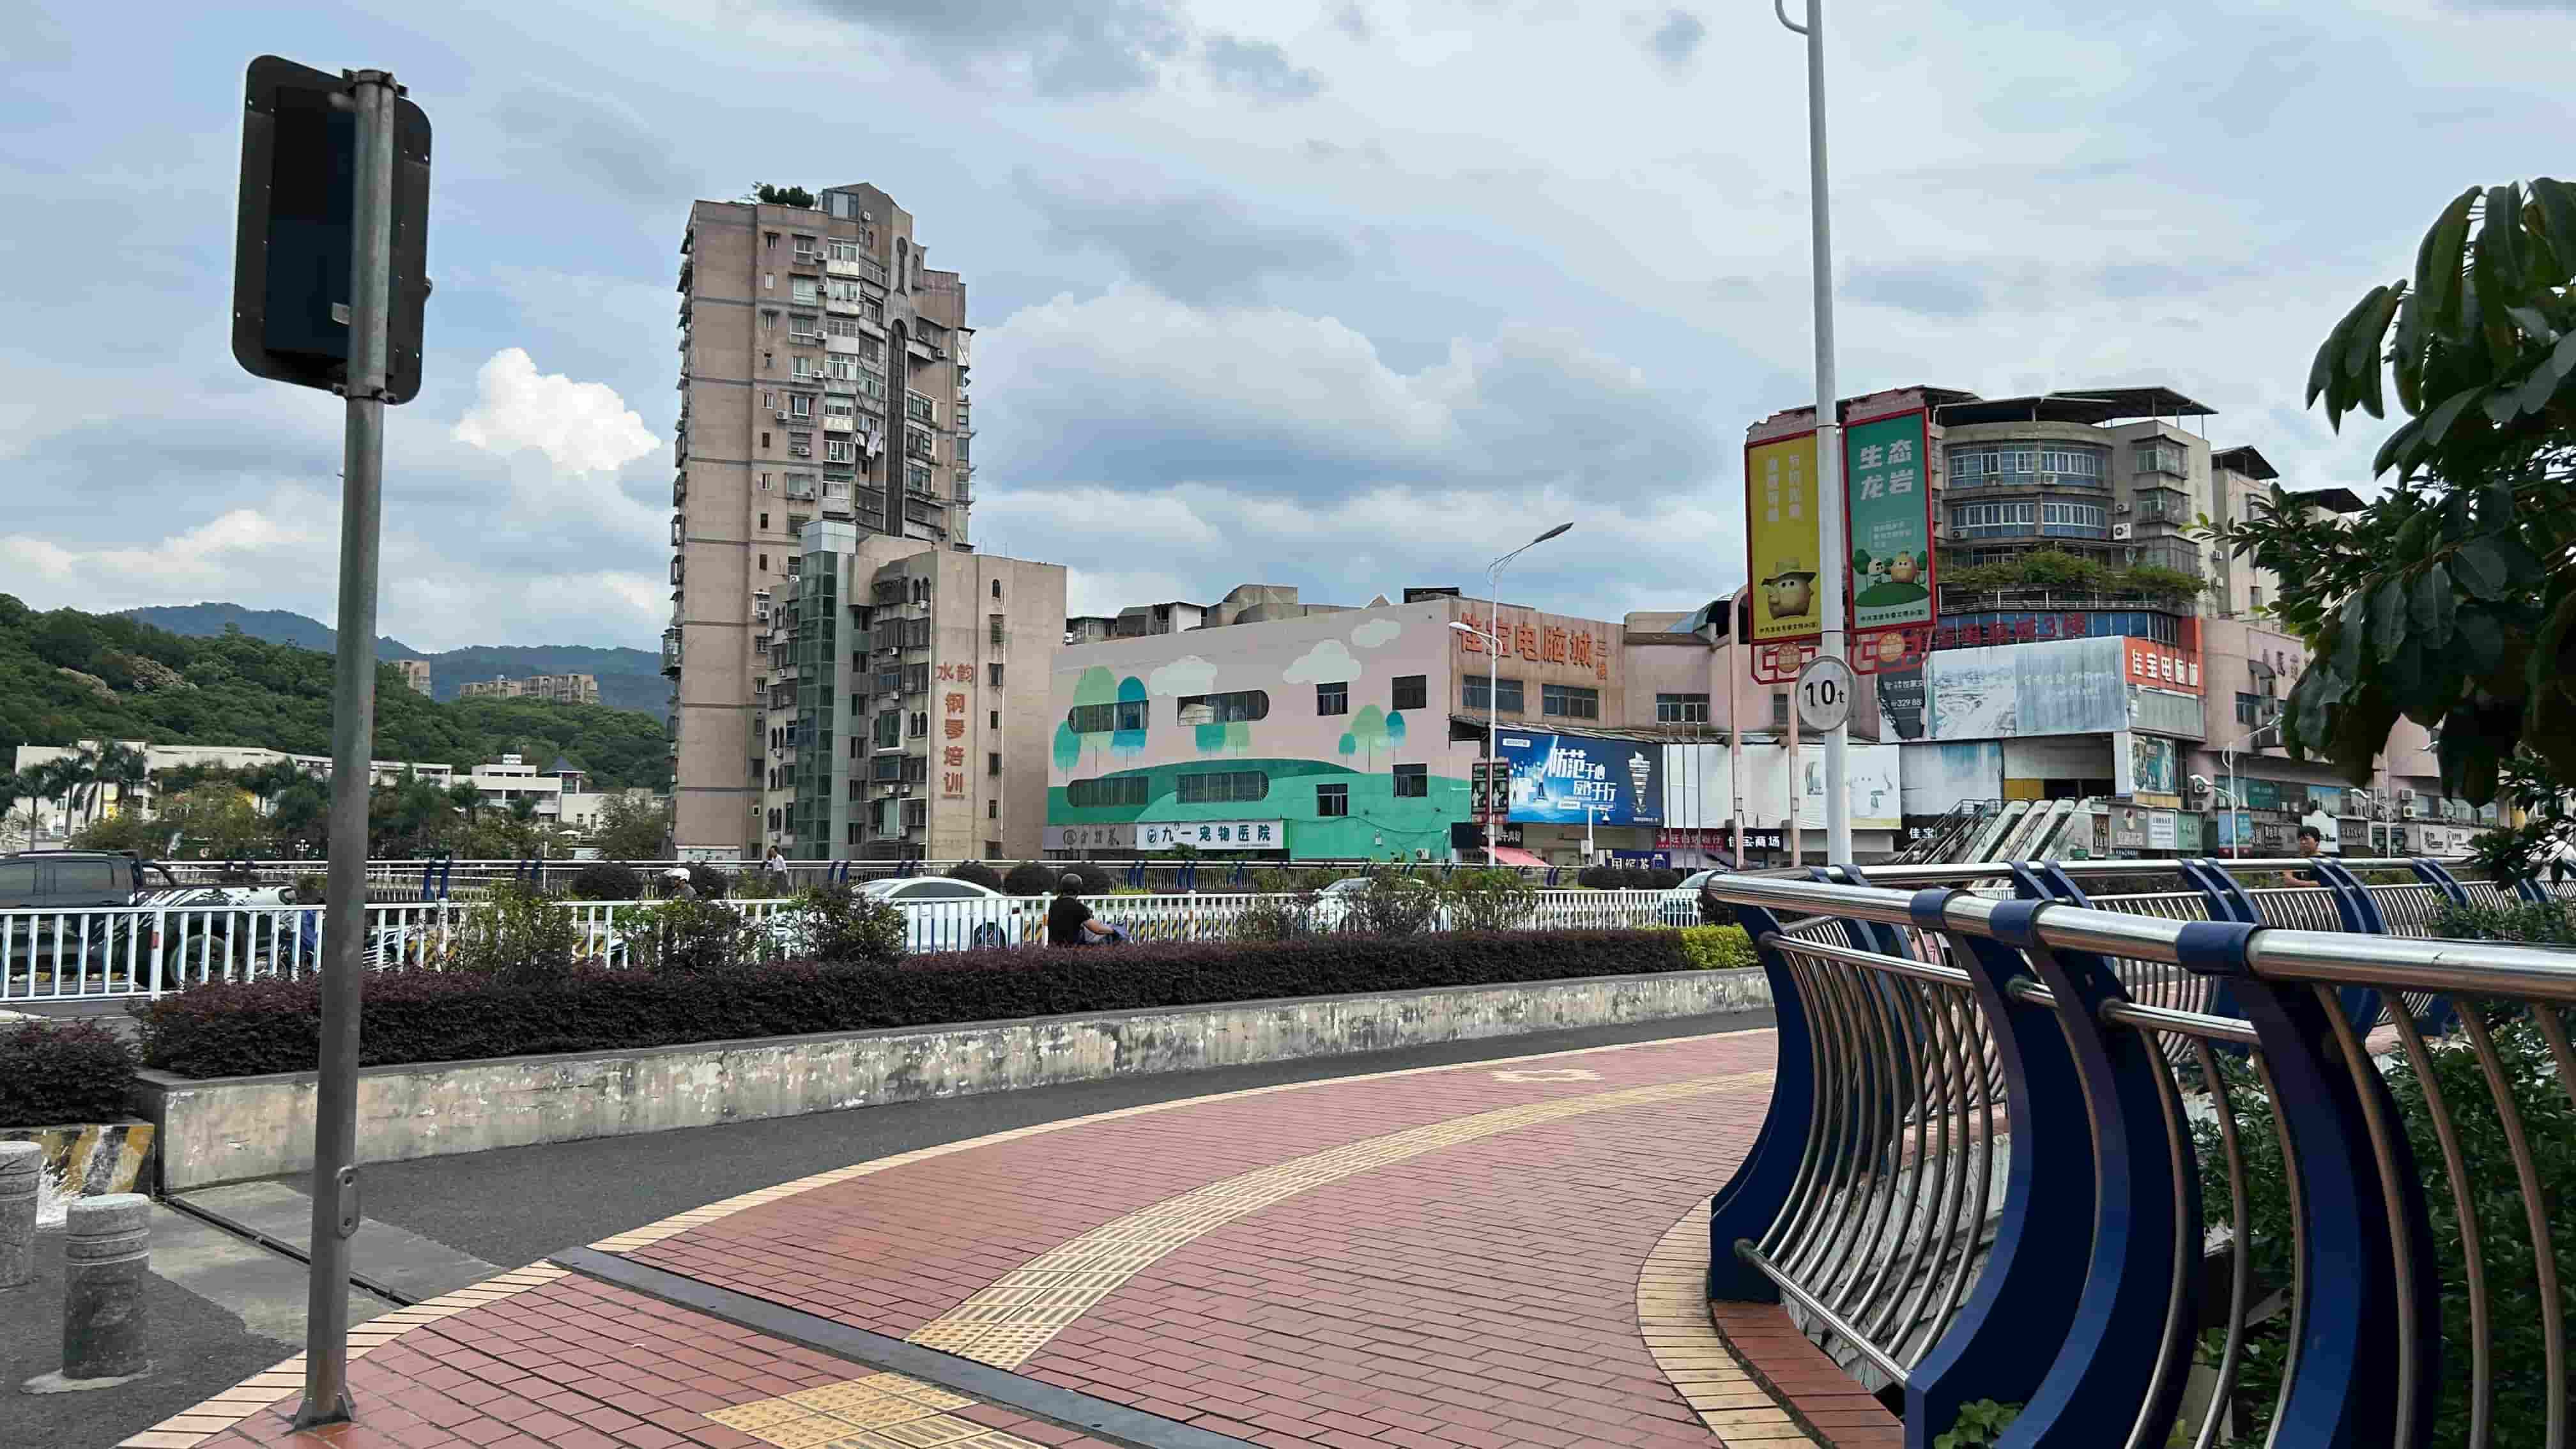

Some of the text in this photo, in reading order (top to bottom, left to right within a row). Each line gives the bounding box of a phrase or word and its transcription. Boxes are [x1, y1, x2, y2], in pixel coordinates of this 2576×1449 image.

[1859, 439, 1913, 470] 生态
[1860, 469, 1914, 500] 龙岩
[1457, 611, 1591, 668] 佳宝电脑城
[937, 662, 974, 683] 水韵
[1805, 679, 1846, 707] 10t
[944, 692, 967, 794] 钢琴培训
[1548, 747, 1607, 781] 防范于心
[1162, 824, 1271, 843] 九一宠物医院
